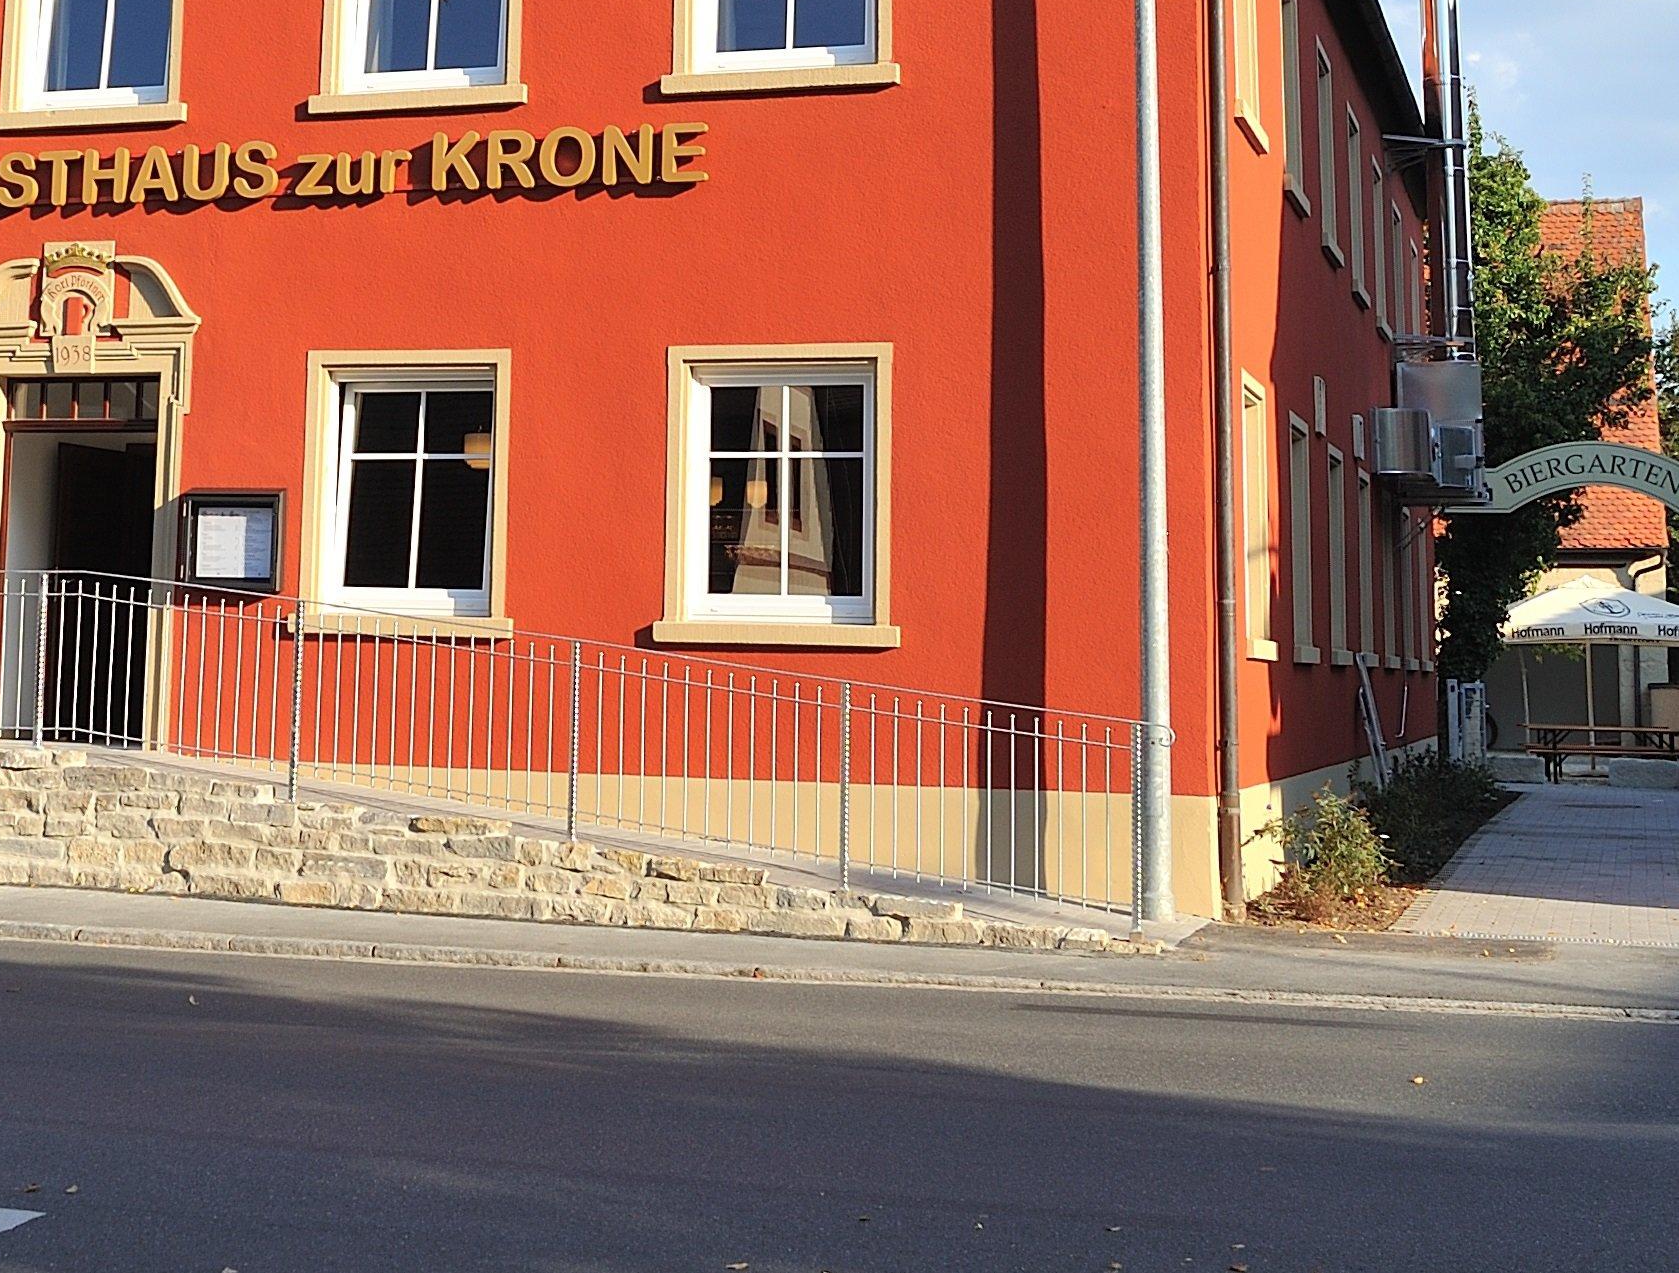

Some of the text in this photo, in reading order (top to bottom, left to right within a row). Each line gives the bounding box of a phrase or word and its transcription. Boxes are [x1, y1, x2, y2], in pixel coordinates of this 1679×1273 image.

[294, 149, 413, 196] zur
[430, 122, 710, 192] KRONE
[55, 345, 92, 367] 1938
[1504, 454, 1679, 495] BIERGARTEN
[1511, 626, 1565, 638] Hofmann
[1584, 622, 1638, 635] Hofmann
